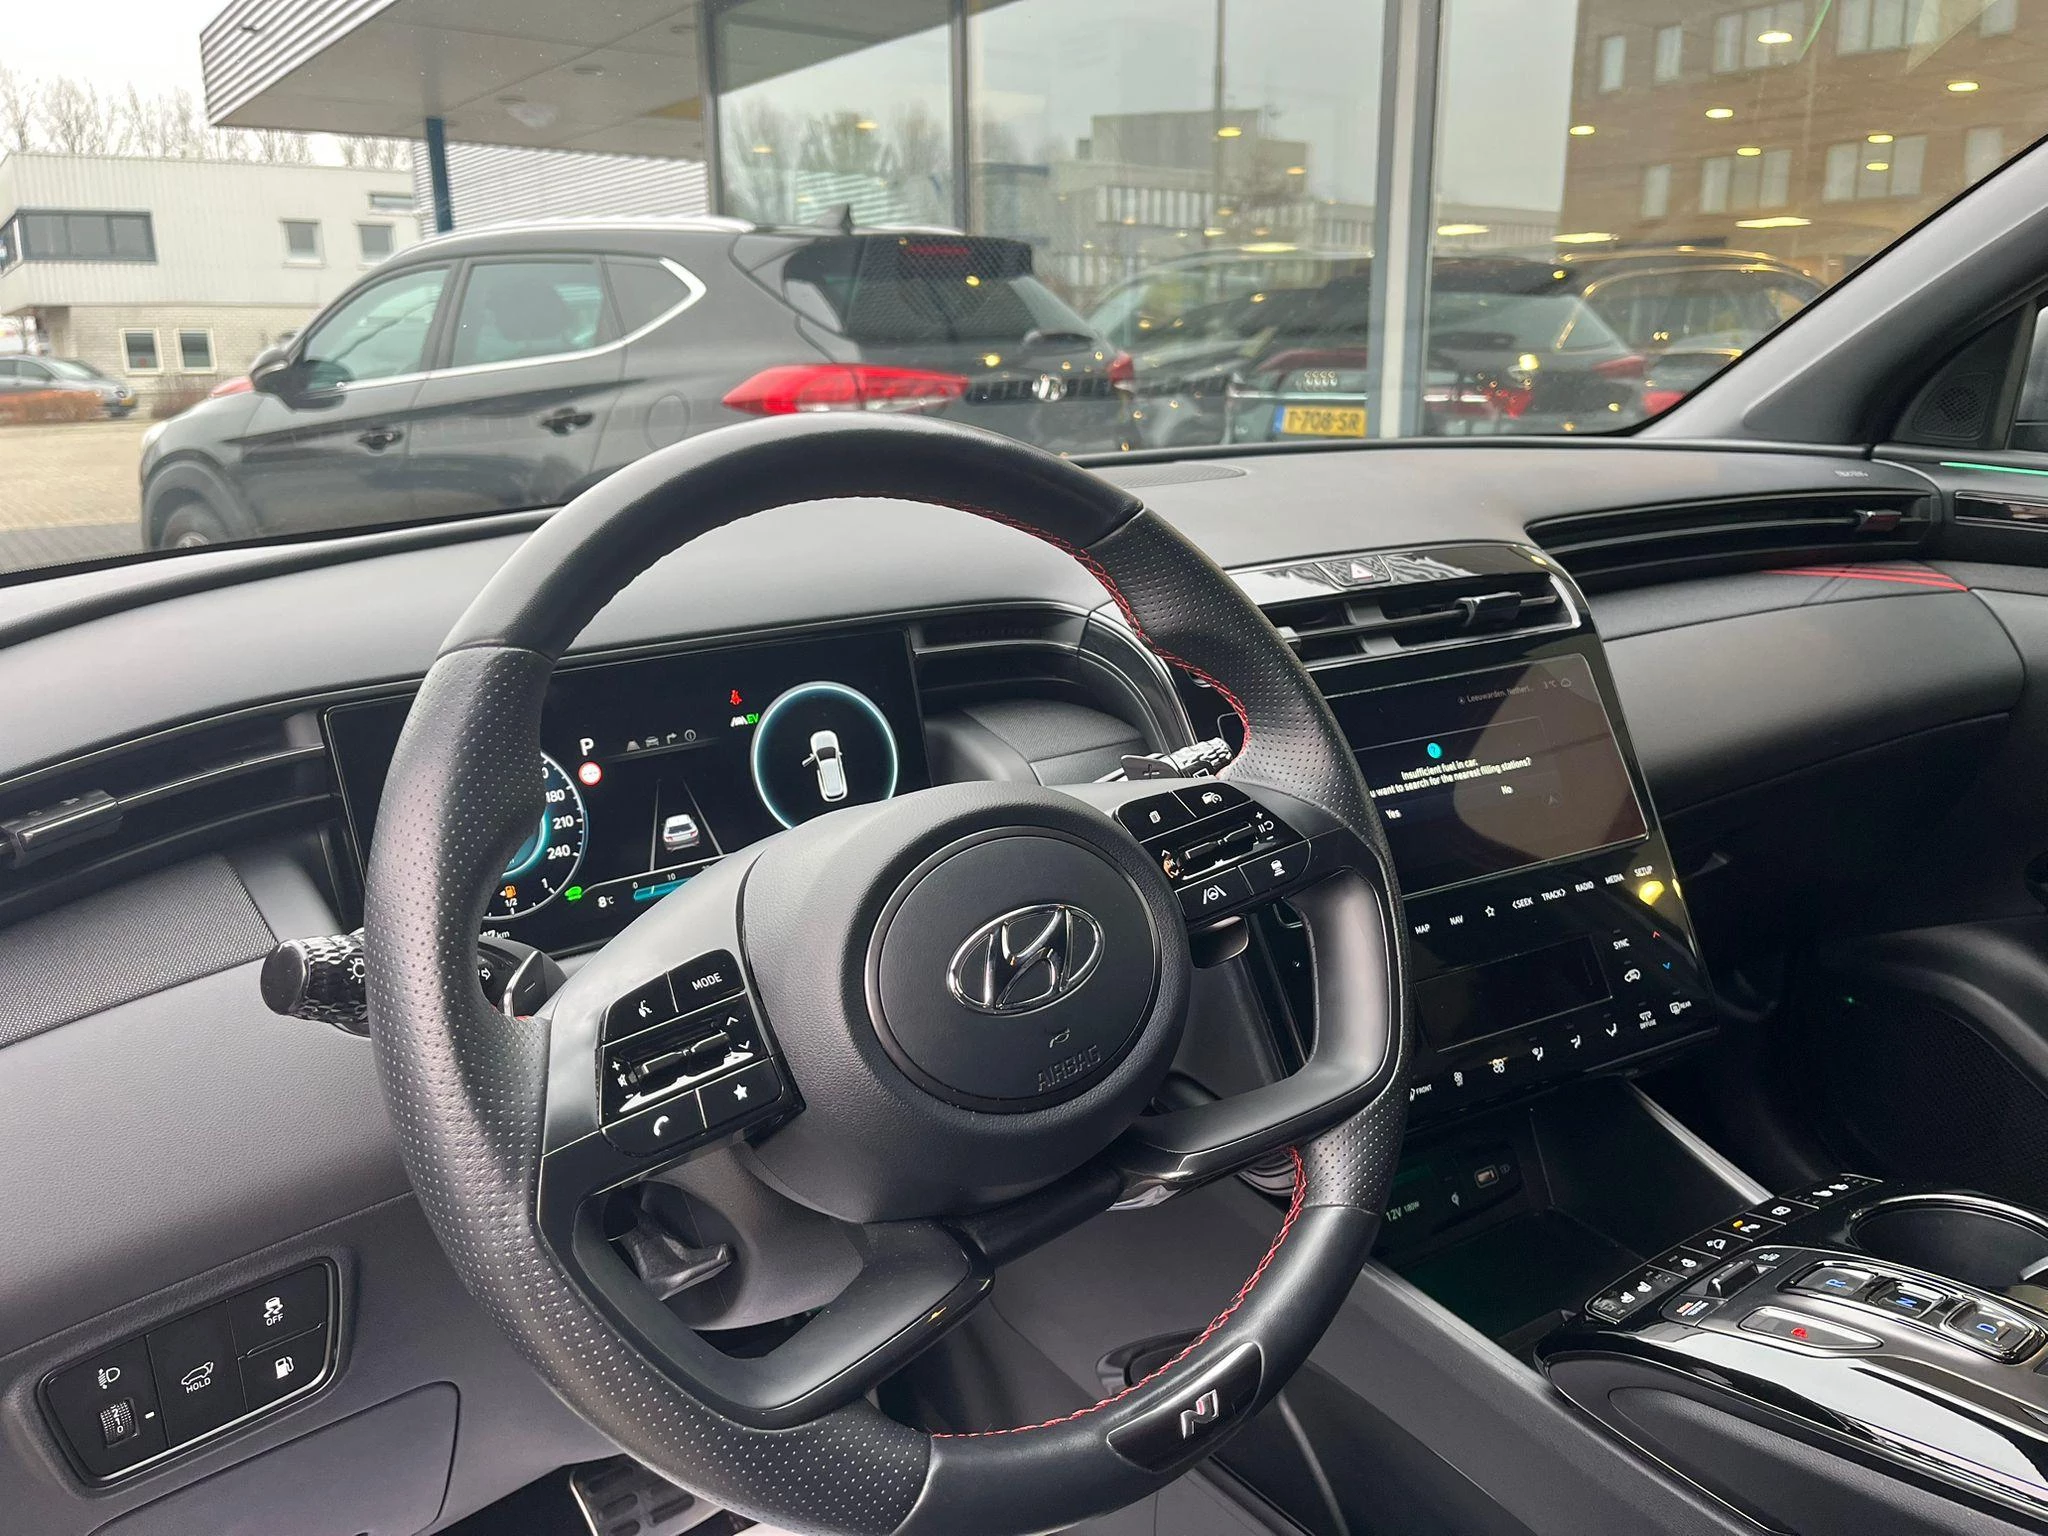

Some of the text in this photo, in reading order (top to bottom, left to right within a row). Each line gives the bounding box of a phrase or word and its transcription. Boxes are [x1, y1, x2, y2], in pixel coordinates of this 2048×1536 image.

[746, 713, 759, 724] EV
[580, 737, 594, 756] P
[1401, 758, 1479, 781] Insufficient fuel in car.
[1376, 785, 1395, 797] want
[1395, 783, 1405, 793] to
[1404, 779, 1430, 792] search
[1430, 776, 1441, 786] for
[1441, 773, 1453, 783] the
[1454, 769, 1481, 781] nearest
[1480, 765, 1501, 776] filling
[1501, 757, 1532, 772] stations?
[545, 789, 566, 803] 180
[1501, 785, 1513, 795] No
[1386, 809, 1402, 819] Yes
[552, 815, 575, 830] 210
[547, 844, 571, 860] 240
[667, 872, 677, 881] 10
[1634, 865, 1653, 878] SETUP
[1605, 873, 1625, 885] MEDIA
[1575, 880, 1595, 893] RADIO
[504, 899, 518, 907] 1/2
[1449, 914, 1463, 926] NAV
[1414, 923, 1430, 935] MAP
[1613, 938, 1631, 951] SYNC
[691, 972, 723, 991] MODE
[1037, 1045, 1101, 1092] AIRBAG
[1415, 1084, 1432, 1096] FRONT
[1386, 1207, 1402, 1222] 12V
[266, 1313, 284, 1326] OFF
[185, 1376, 211, 1393] HOLD
[111, 1408, 120, 1418] 2
[116, 1425, 124, 1433] 0
